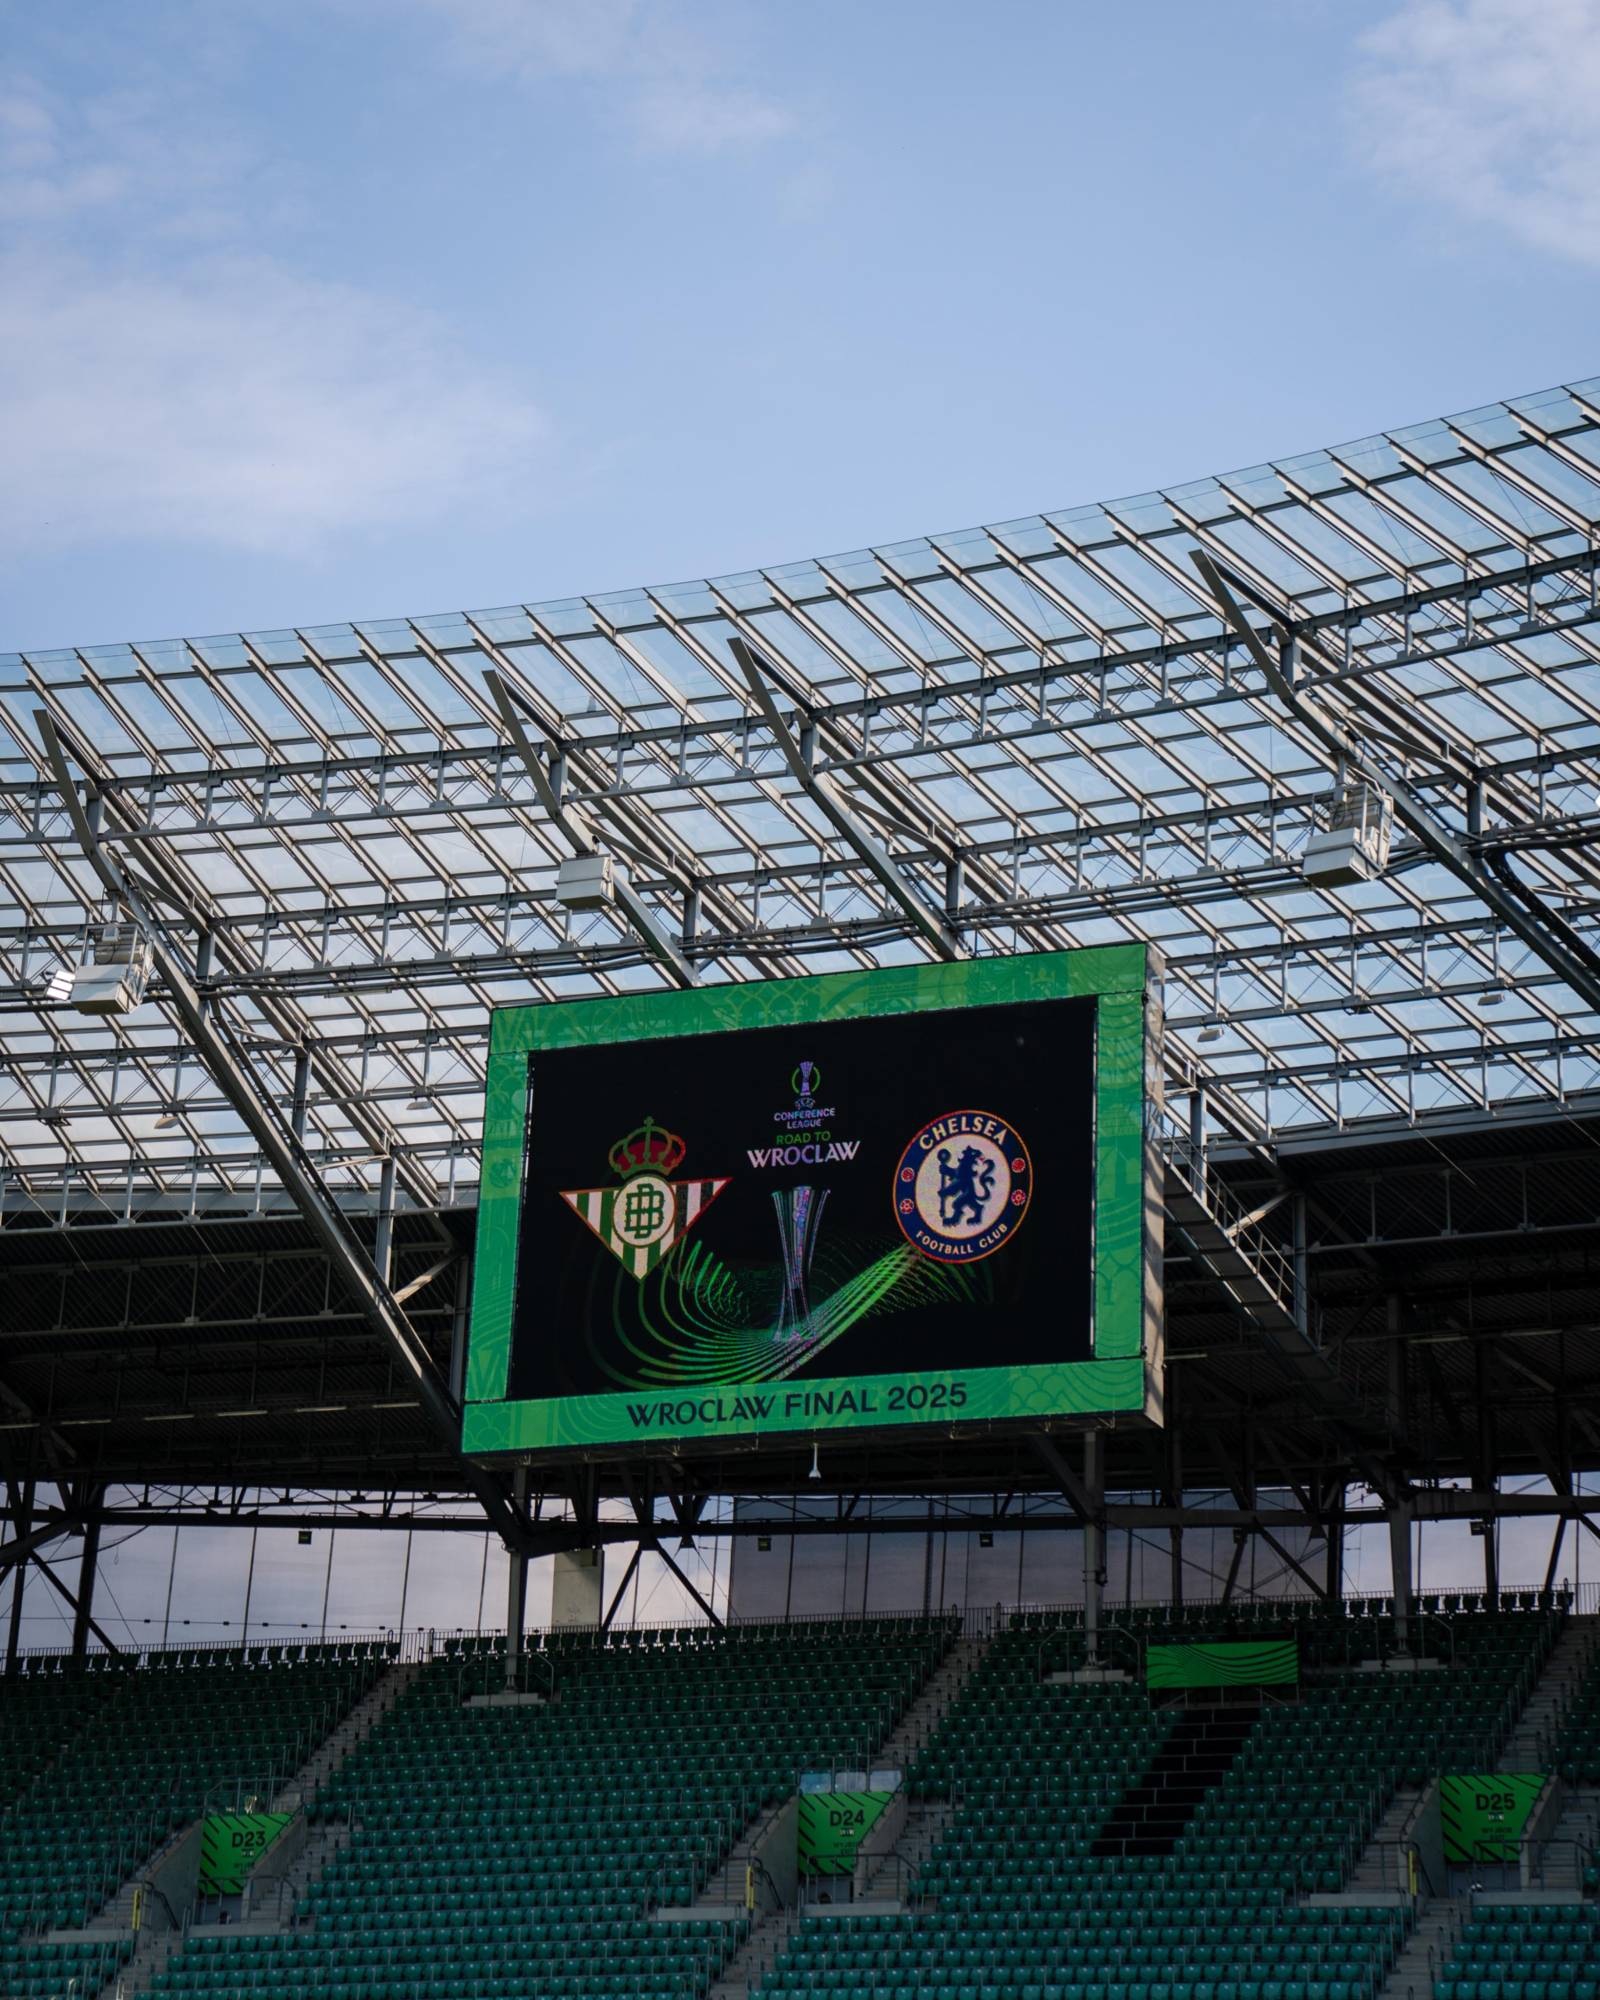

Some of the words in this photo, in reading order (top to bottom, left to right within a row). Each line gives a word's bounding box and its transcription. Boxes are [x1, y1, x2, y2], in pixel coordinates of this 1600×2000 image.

[774, 1107, 836, 1121] CONFERENCE
[786, 1119, 822, 1130] LEAGUE
[919, 1116, 1008, 1149] CHELSEA
[776, 1132, 811, 1145] ROAD
[814, 1131, 831, 1142] TO
[747, 1140, 860, 1168] WROCLAW
[916, 1230, 974, 1255] FOOTBALL
[979, 1223, 1008, 1248] CLUB
[626, 1394, 776, 1427] WROCLAW
[784, 1385, 878, 1418] FINAL
[887, 1382, 967, 1411] 2025
[1475, 1792, 1516, 1811] D25
[829, 1808, 865, 1827] D24
[231, 1830, 266, 1848] D23
